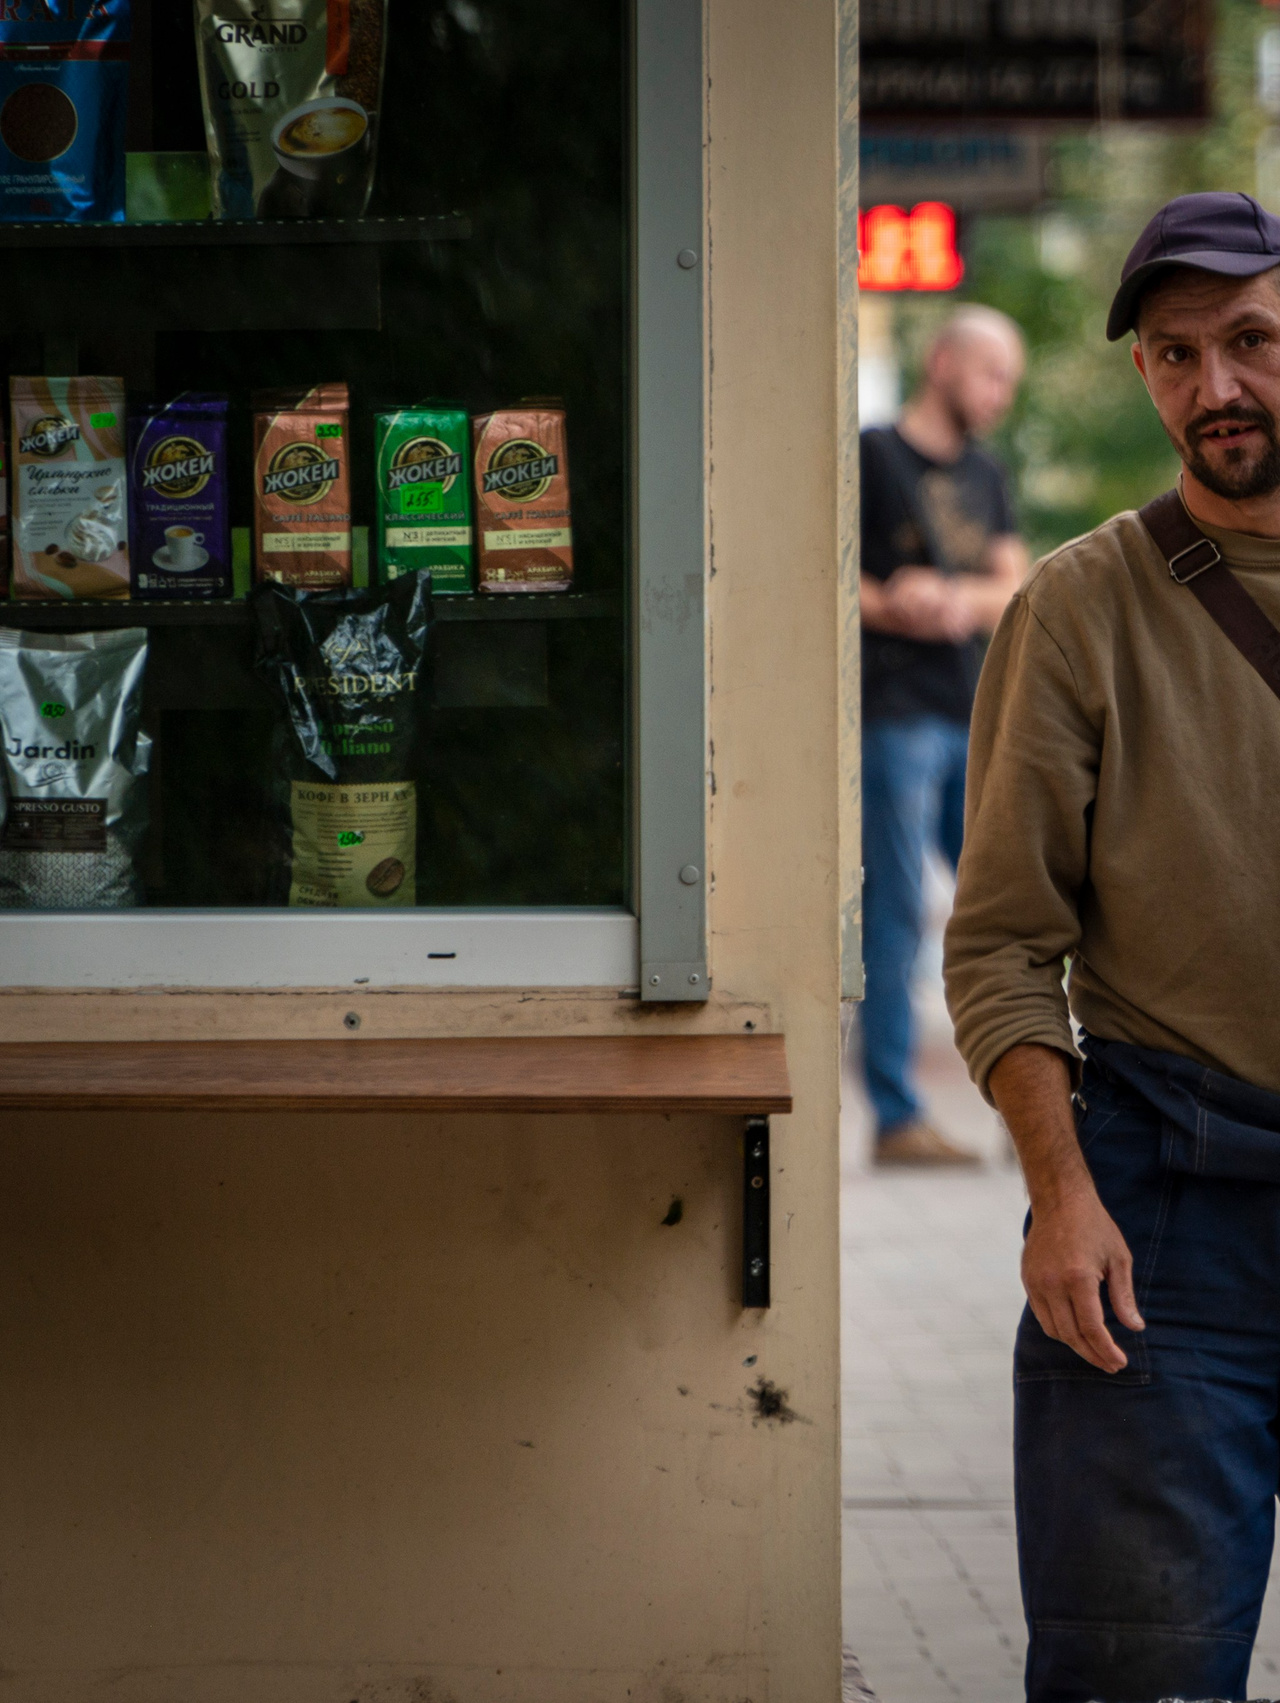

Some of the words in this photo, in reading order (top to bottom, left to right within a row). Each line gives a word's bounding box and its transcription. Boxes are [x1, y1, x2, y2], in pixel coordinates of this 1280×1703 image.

[215, 24, 308, 47] GRAND
[218, 81, 280, 99] GOLD
[143, 452, 214, 487] ЖОКЕЙ
[265, 458, 337, 493] ЖОКЕЙ
[389, 453, 460, 488] ЖОКЕЙ
[485, 455, 556, 492] ЖОКЕЙ
[146, 502, 215, 512] ТРАДИЦИОННЫЙ
[384, 511, 465, 521] КЛАССИЧЕСКИЙ
[293, 672, 418, 695] PESIDENT
[5, 738, 95, 759] Jardin
[61, 802, 100, 813] GUSTO
[298, 790, 335, 802] КОФЕ
[340, 793, 349, 803] В
[354, 790, 408, 803] ЗЕРНАХ
